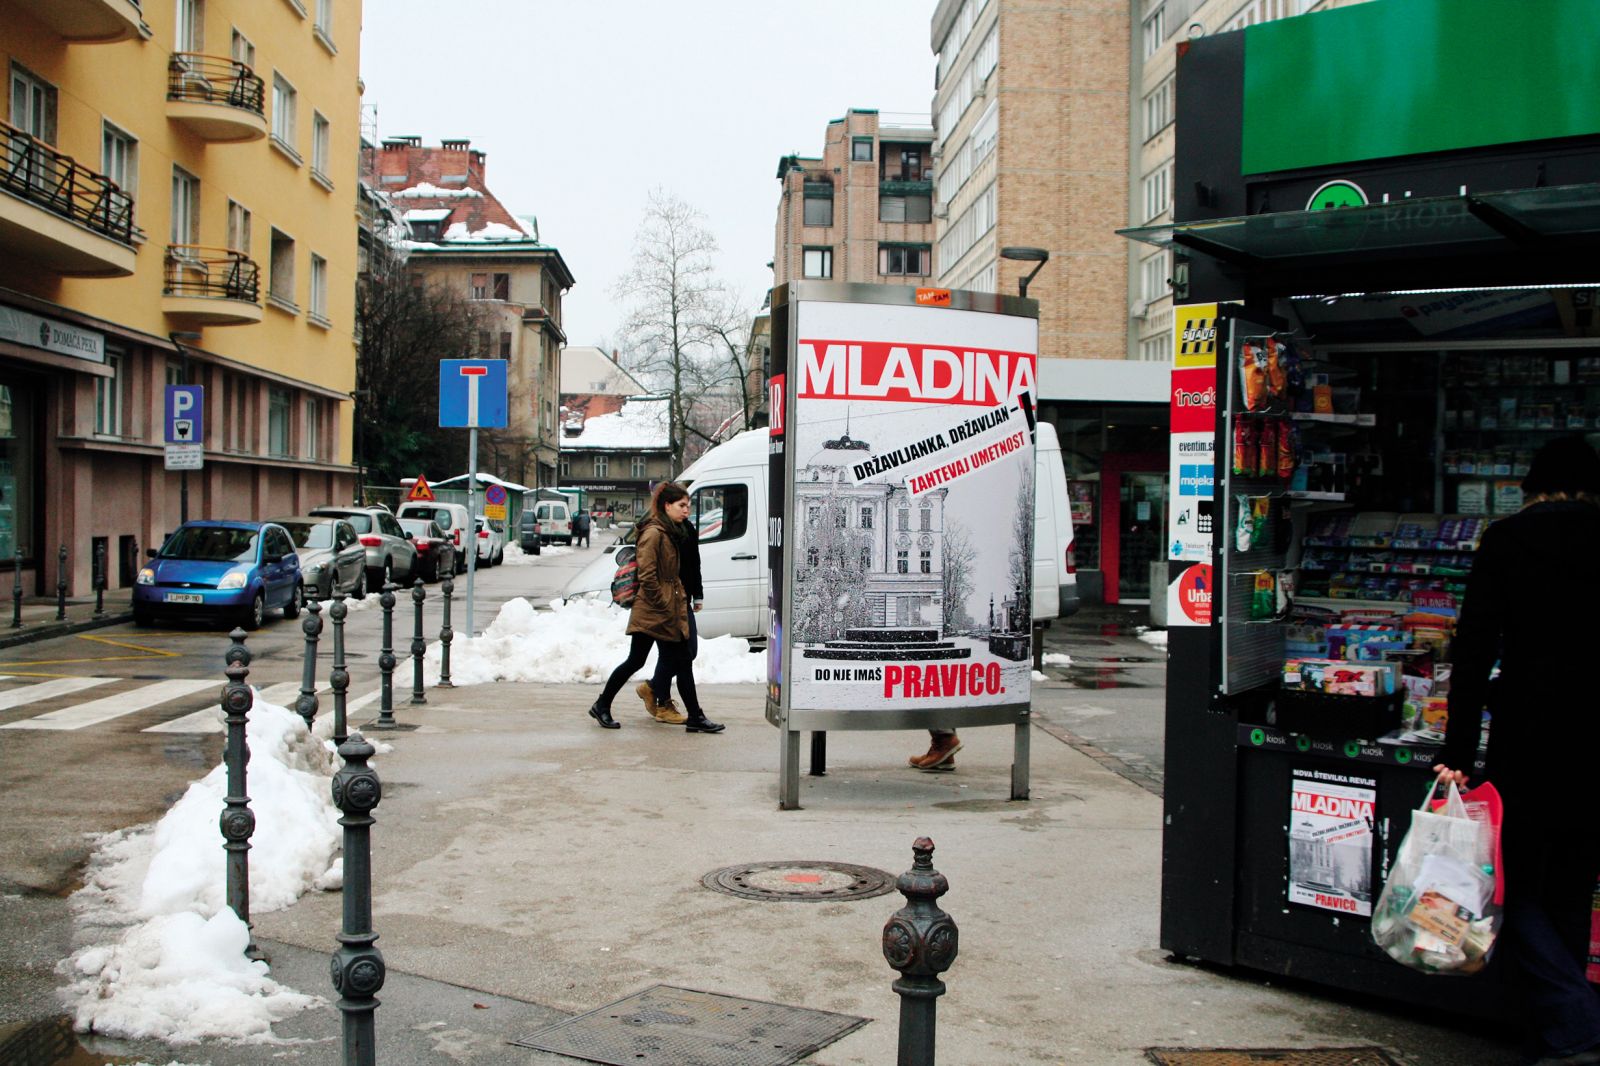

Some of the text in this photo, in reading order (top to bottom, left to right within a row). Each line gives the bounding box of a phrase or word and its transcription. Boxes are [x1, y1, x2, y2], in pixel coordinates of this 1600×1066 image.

[798, 343, 1037, 403] MLADINA
[174, 390, 193, 418] P
[853, 433, 949, 481] DRŽAVLJANKA,
[949, 405, 1009, 445] DRŽAVLJAN
[909, 431, 1025, 495] ZAHTEVAJ UMETNOST
[1199, 513, 1212, 521] bob
[815, 662, 1006, 698] DO NJE IMAŠ PRAVICO.
[1266, 734, 1286, 745] kiosk
[1293, 769, 1376, 787] NOVA ŠTEVILKA REVIJE
[1292, 792, 1374, 819] MLADINA
[1315, 893, 1358, 912] PRAVICO.
